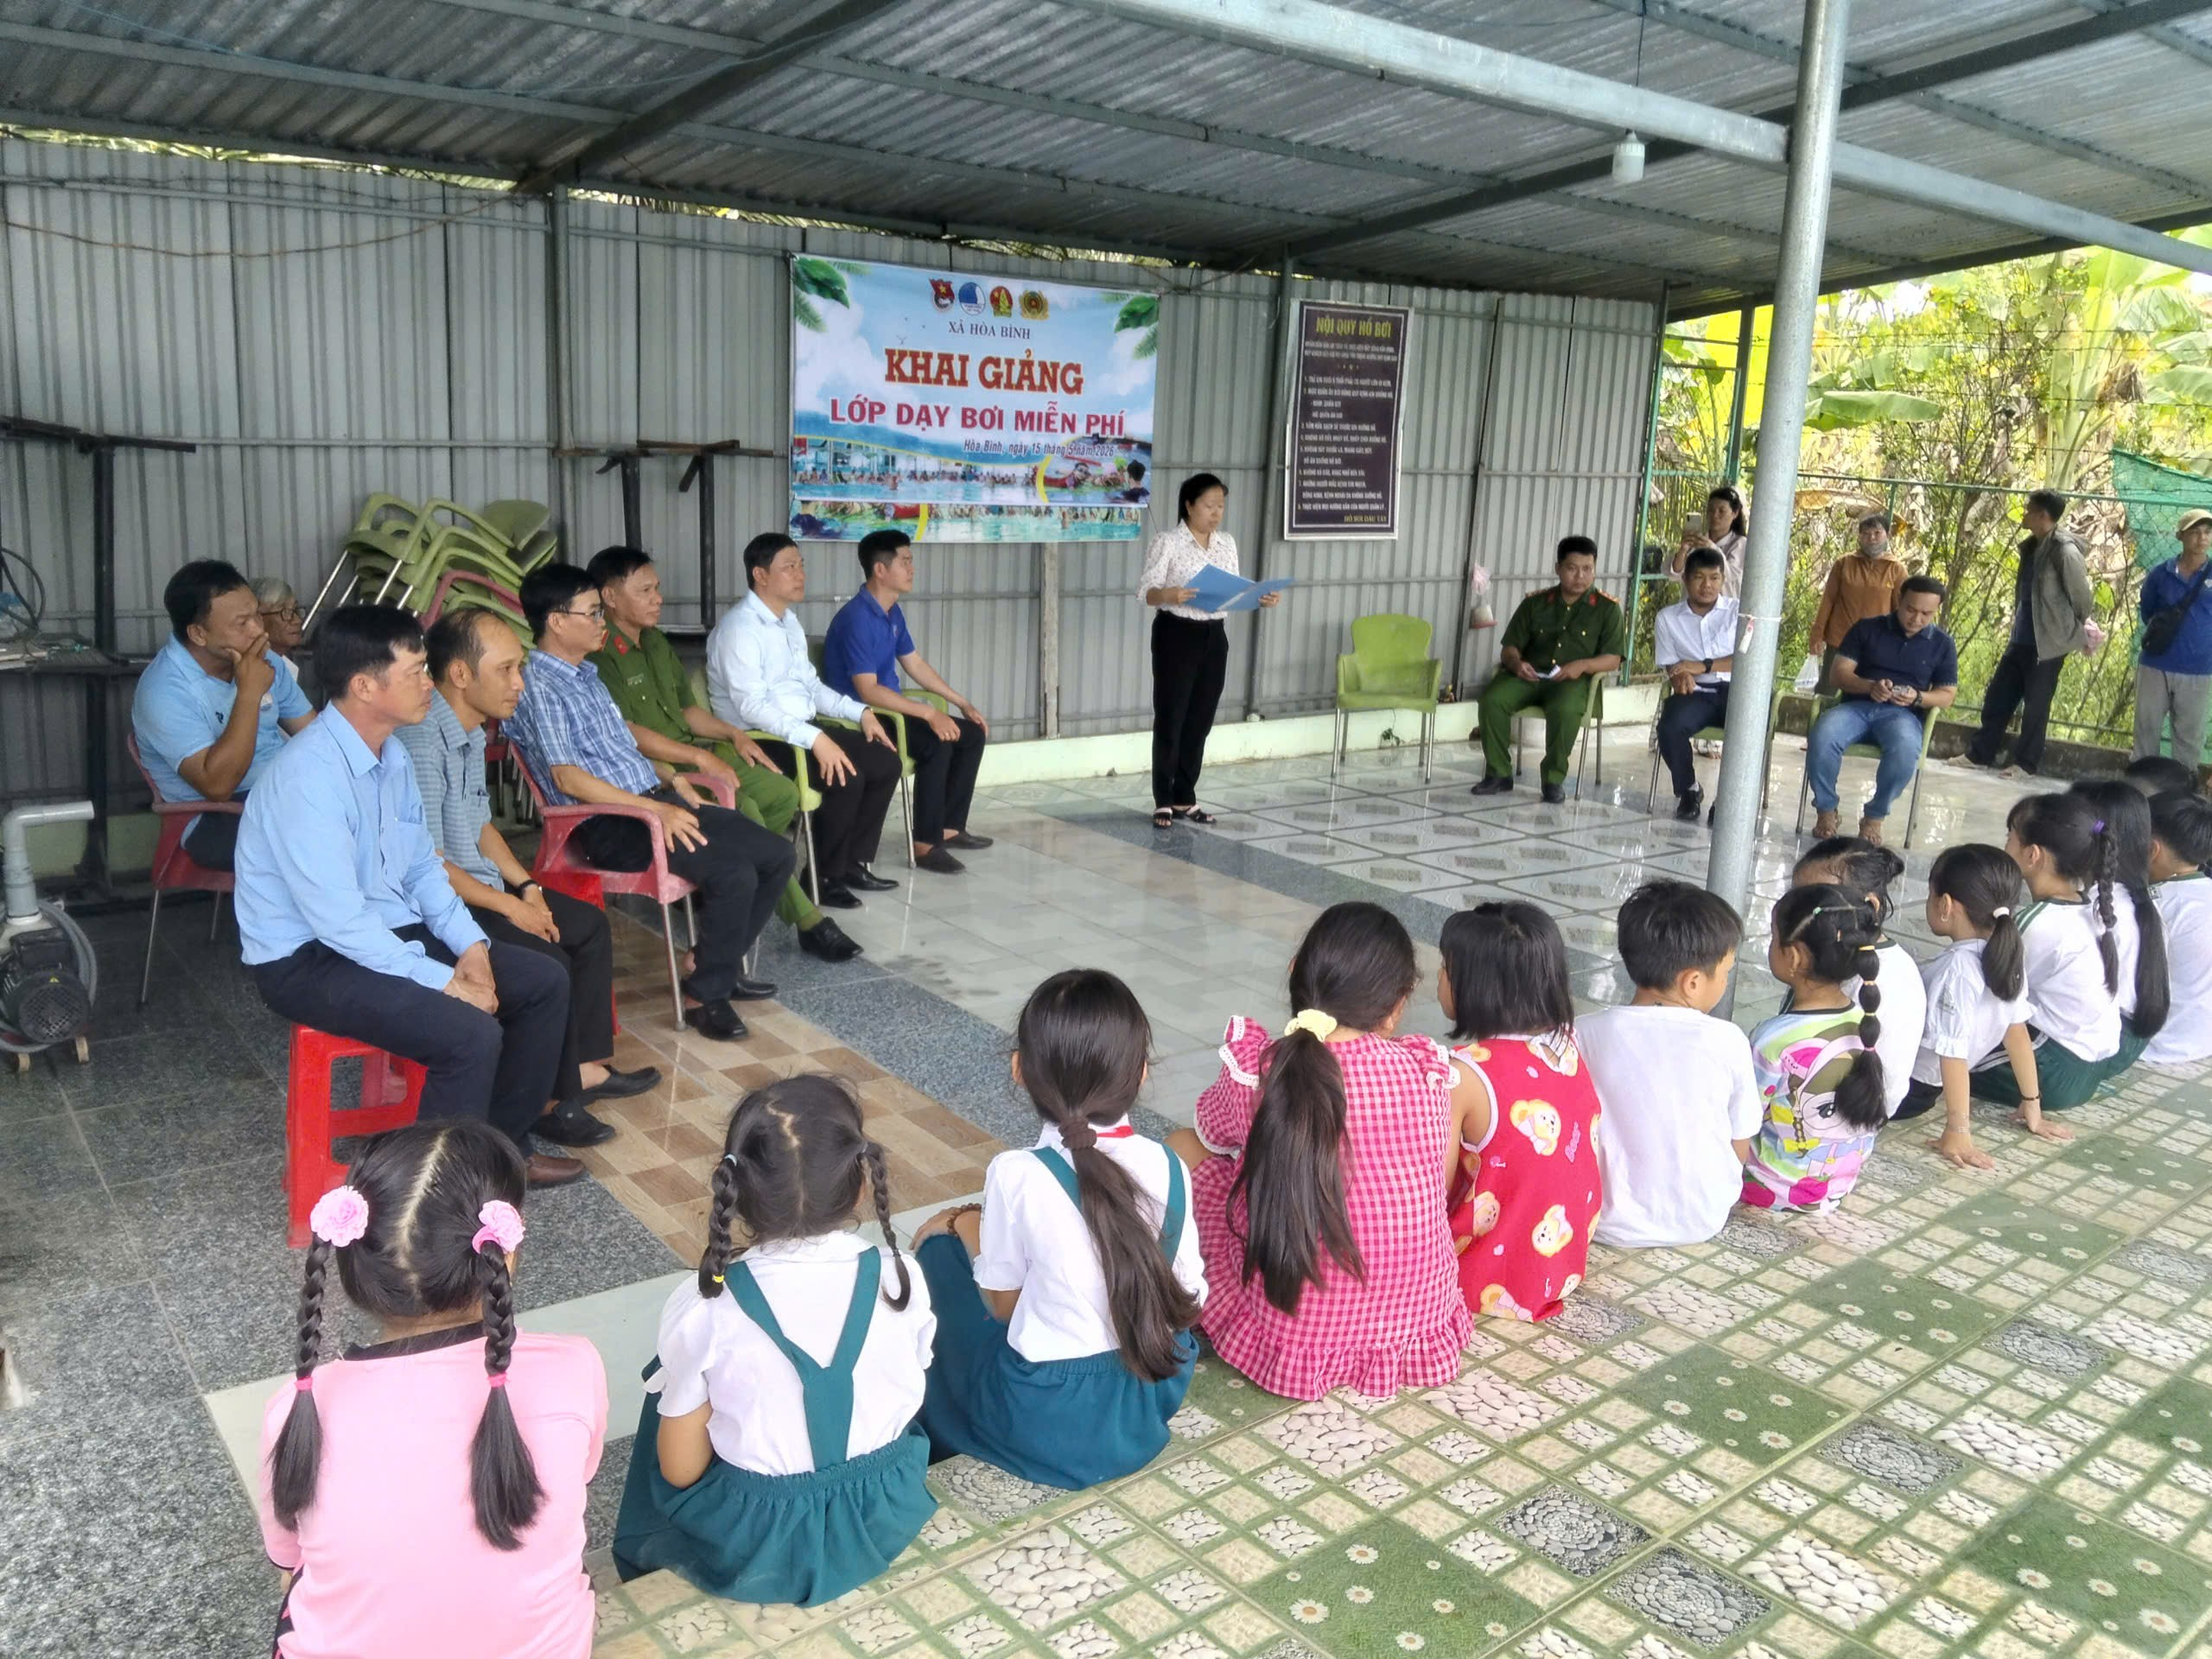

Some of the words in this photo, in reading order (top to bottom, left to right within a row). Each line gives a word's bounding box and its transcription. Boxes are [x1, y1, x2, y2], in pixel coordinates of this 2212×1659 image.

[969, 321, 996, 337] HÒA
[1001, 323, 1031, 340] BÌNH
[1316, 315, 1335, 336] NỘI
[1337, 318, 1357, 336] QUY
[885, 348, 969, 387] KHAI
[978, 348, 1084, 395] GIẢNG
[830, 394, 887, 424] LỚP
[896, 403, 950, 431] DẠY
[961, 404, 1004, 430] BƠI
[1014, 400, 1077, 434] MIỄN
[1085, 410, 1125, 436] PHÍ
[963, 439, 981, 452] Hòa
[1008, 443, 1028, 457] ngày
[1032, 443, 1040, 454] 15
[1043, 442, 1065, 457] tháng
